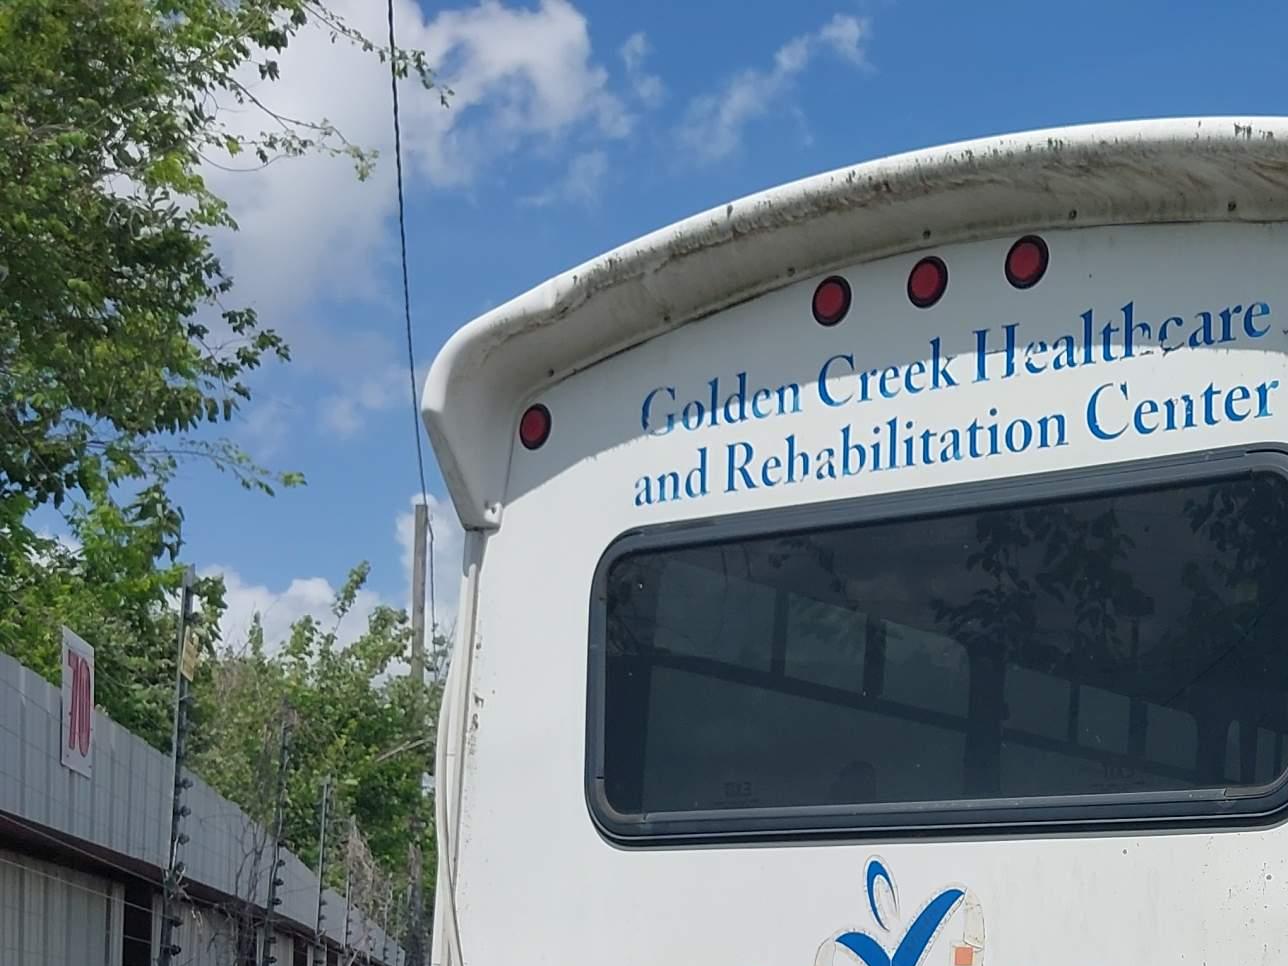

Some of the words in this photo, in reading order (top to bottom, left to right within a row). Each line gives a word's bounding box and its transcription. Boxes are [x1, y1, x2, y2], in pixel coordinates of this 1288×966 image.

[641, 371, 801, 437] Golden
[818, 337, 956, 408] Creek
[972, 301, 1271, 383] Healthcare
[633, 447, 708, 507] and
[726, 406, 1068, 493] Rehabilitation
[1085, 378, 1278, 441] Center
[68, 649, 91, 757] 10
